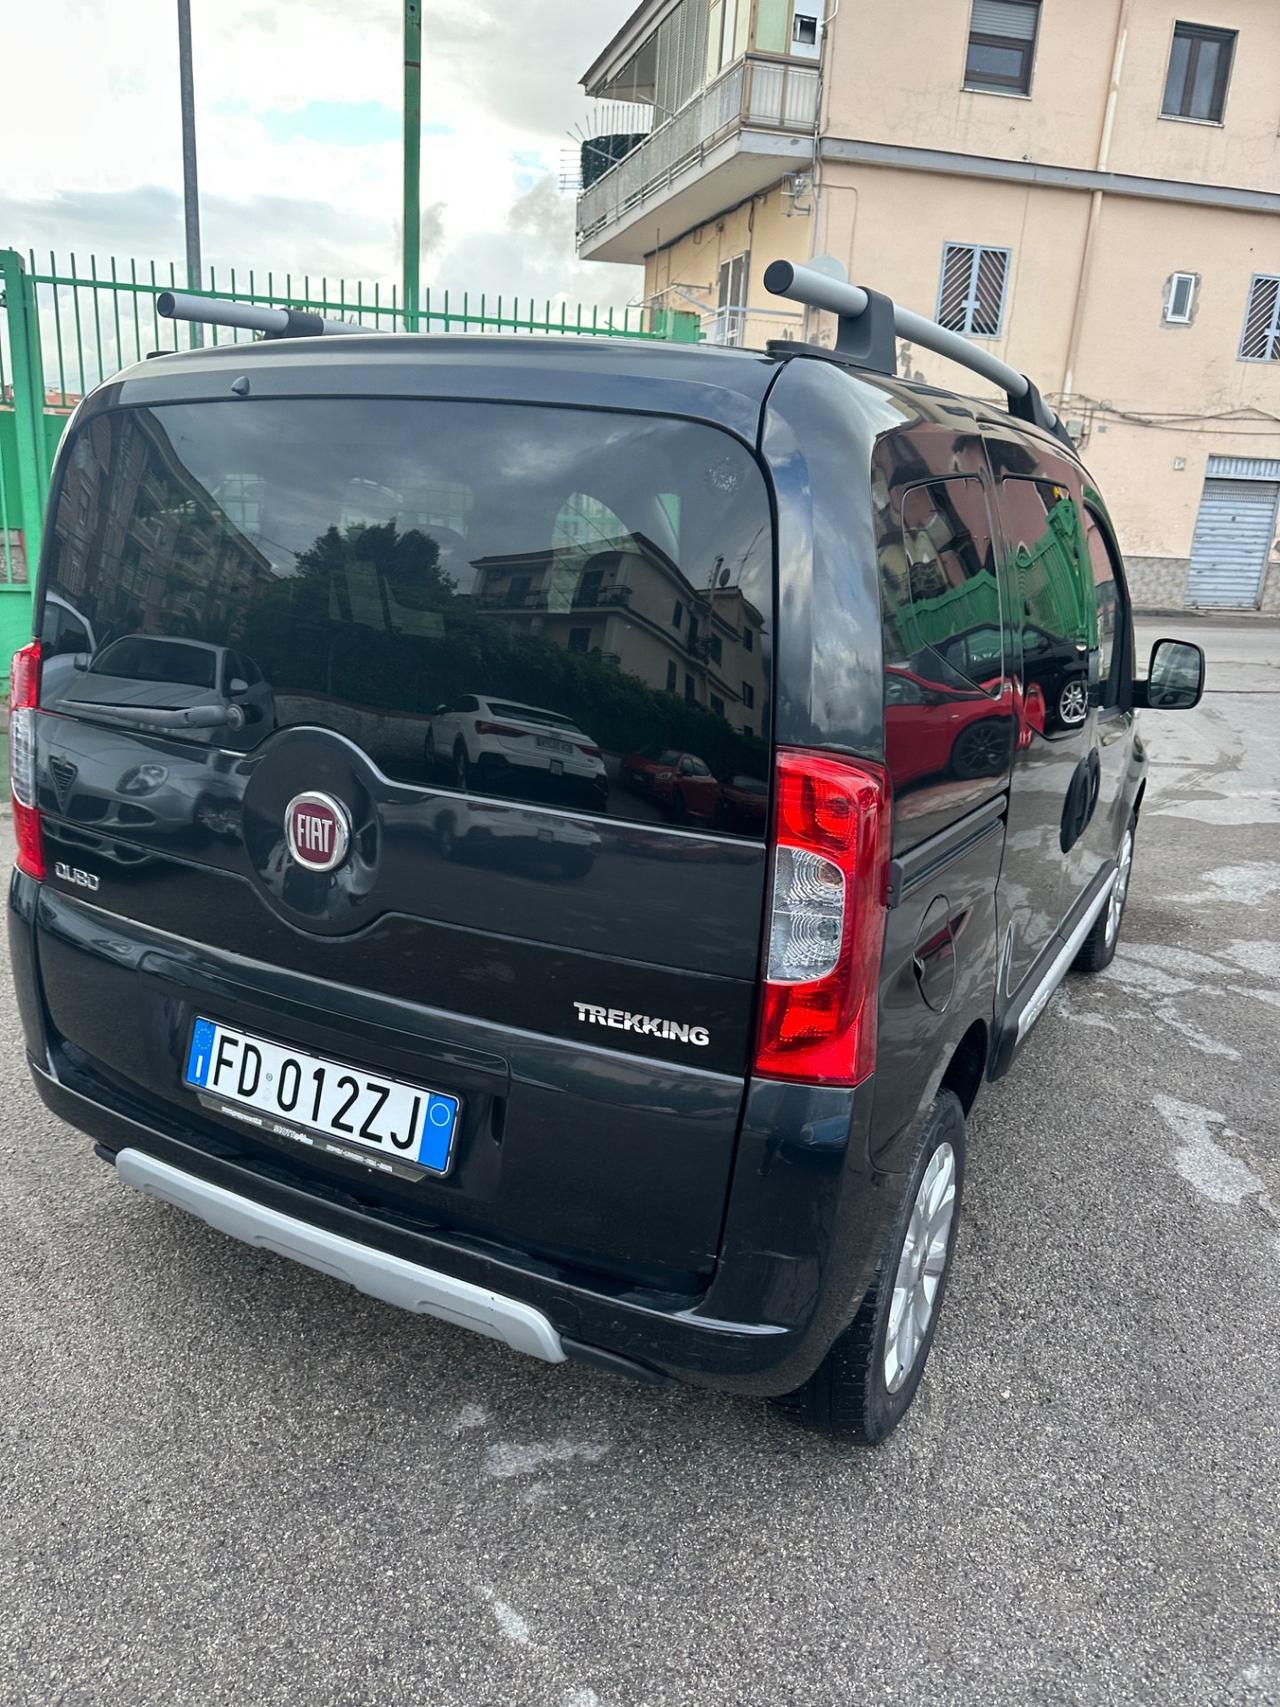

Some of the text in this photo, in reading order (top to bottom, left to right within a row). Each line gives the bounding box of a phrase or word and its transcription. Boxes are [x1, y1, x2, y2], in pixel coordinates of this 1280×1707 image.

[297, 813, 333, 853] FIAT
[55, 861, 99, 891] QUBO
[573, 1001, 710, 1046] TREKKING
[195, 1055, 203, 1078] I
[213, 1034, 422, 1150] FD 012ZJ
